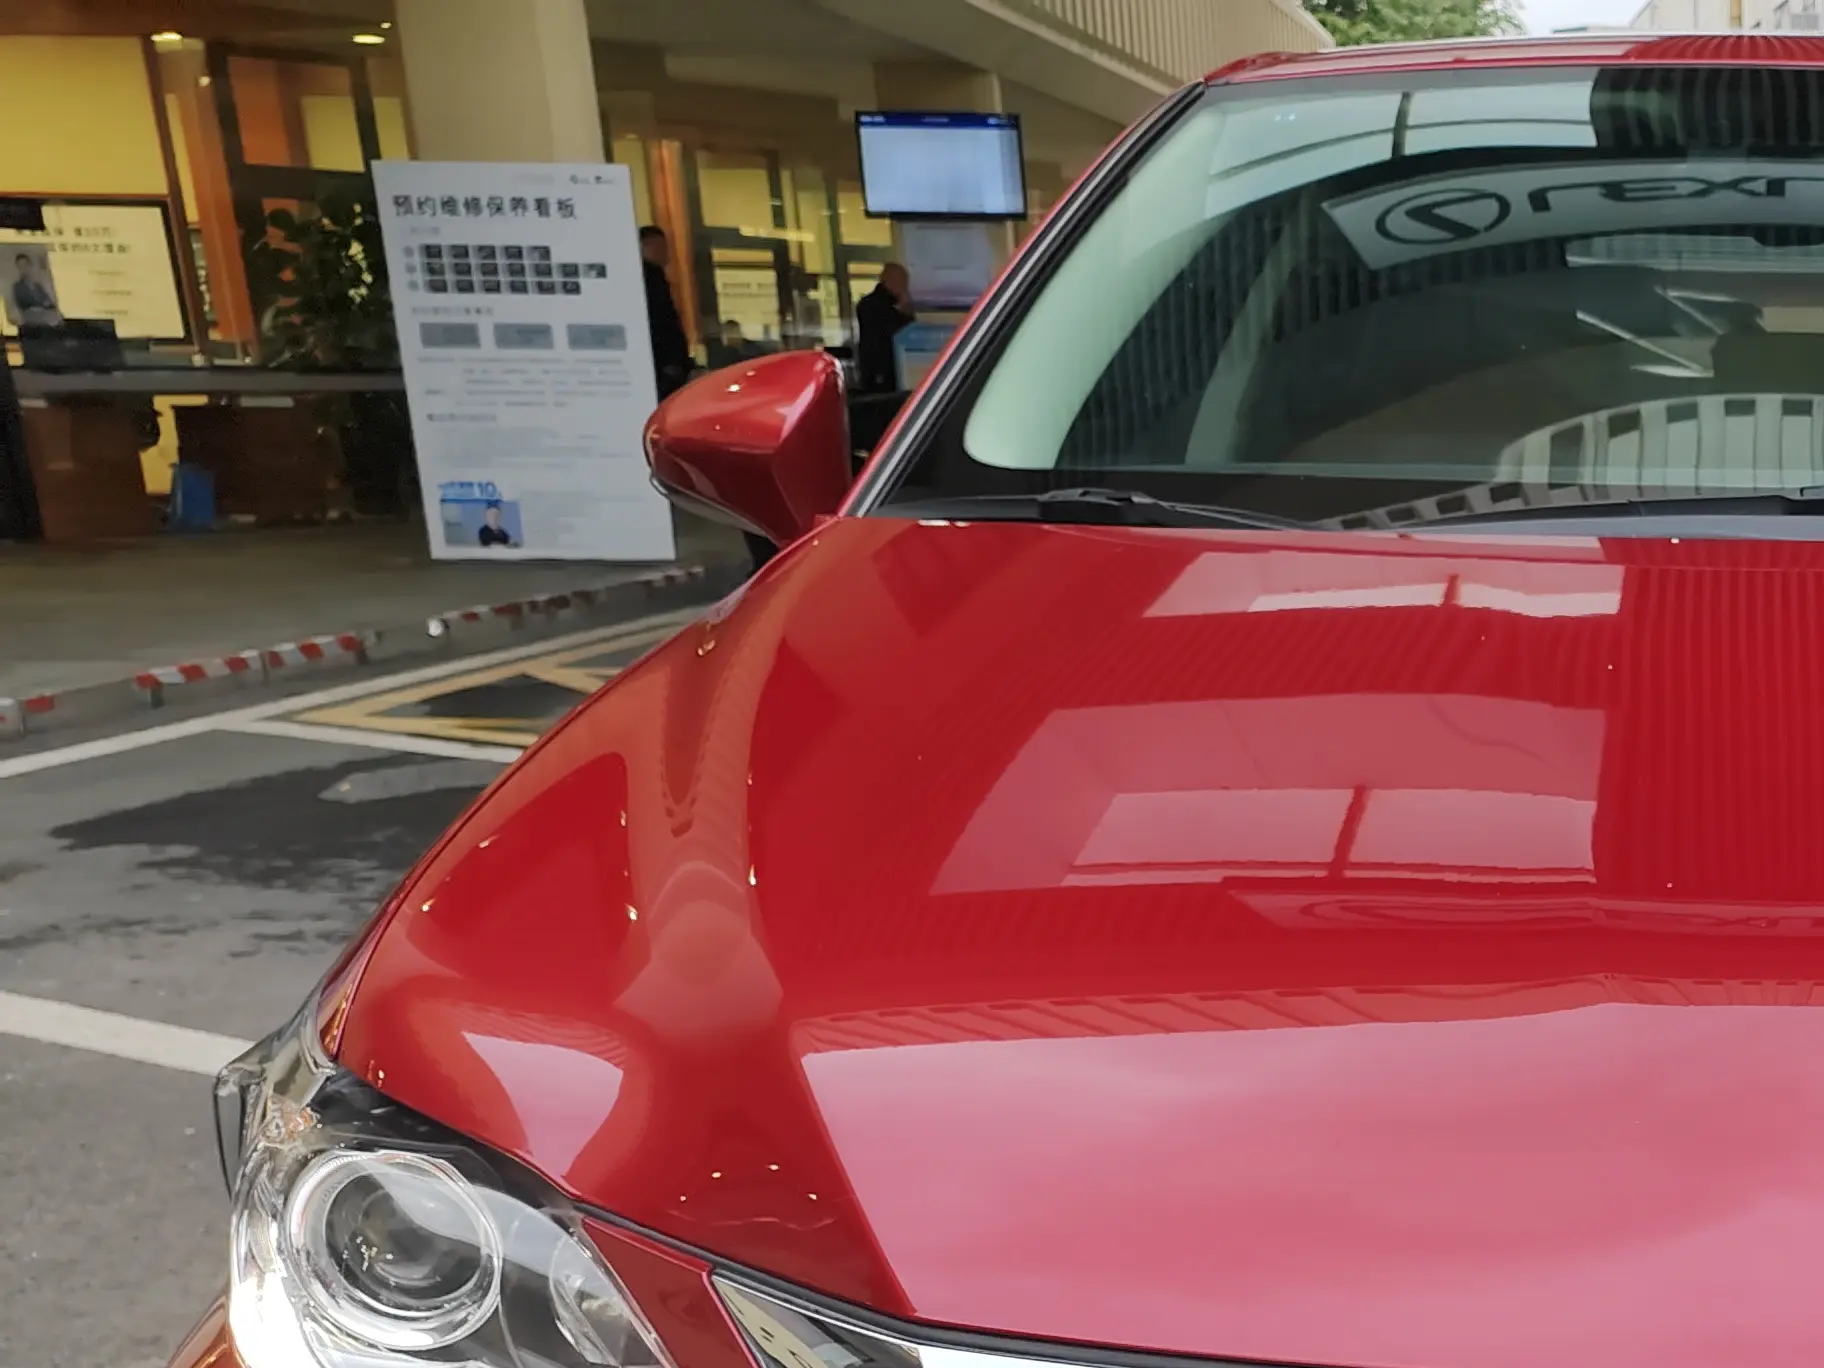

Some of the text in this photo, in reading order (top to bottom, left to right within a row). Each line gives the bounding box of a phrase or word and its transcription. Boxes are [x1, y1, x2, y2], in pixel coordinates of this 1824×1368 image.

[392, 194, 578, 221] 预约维修保养看板
